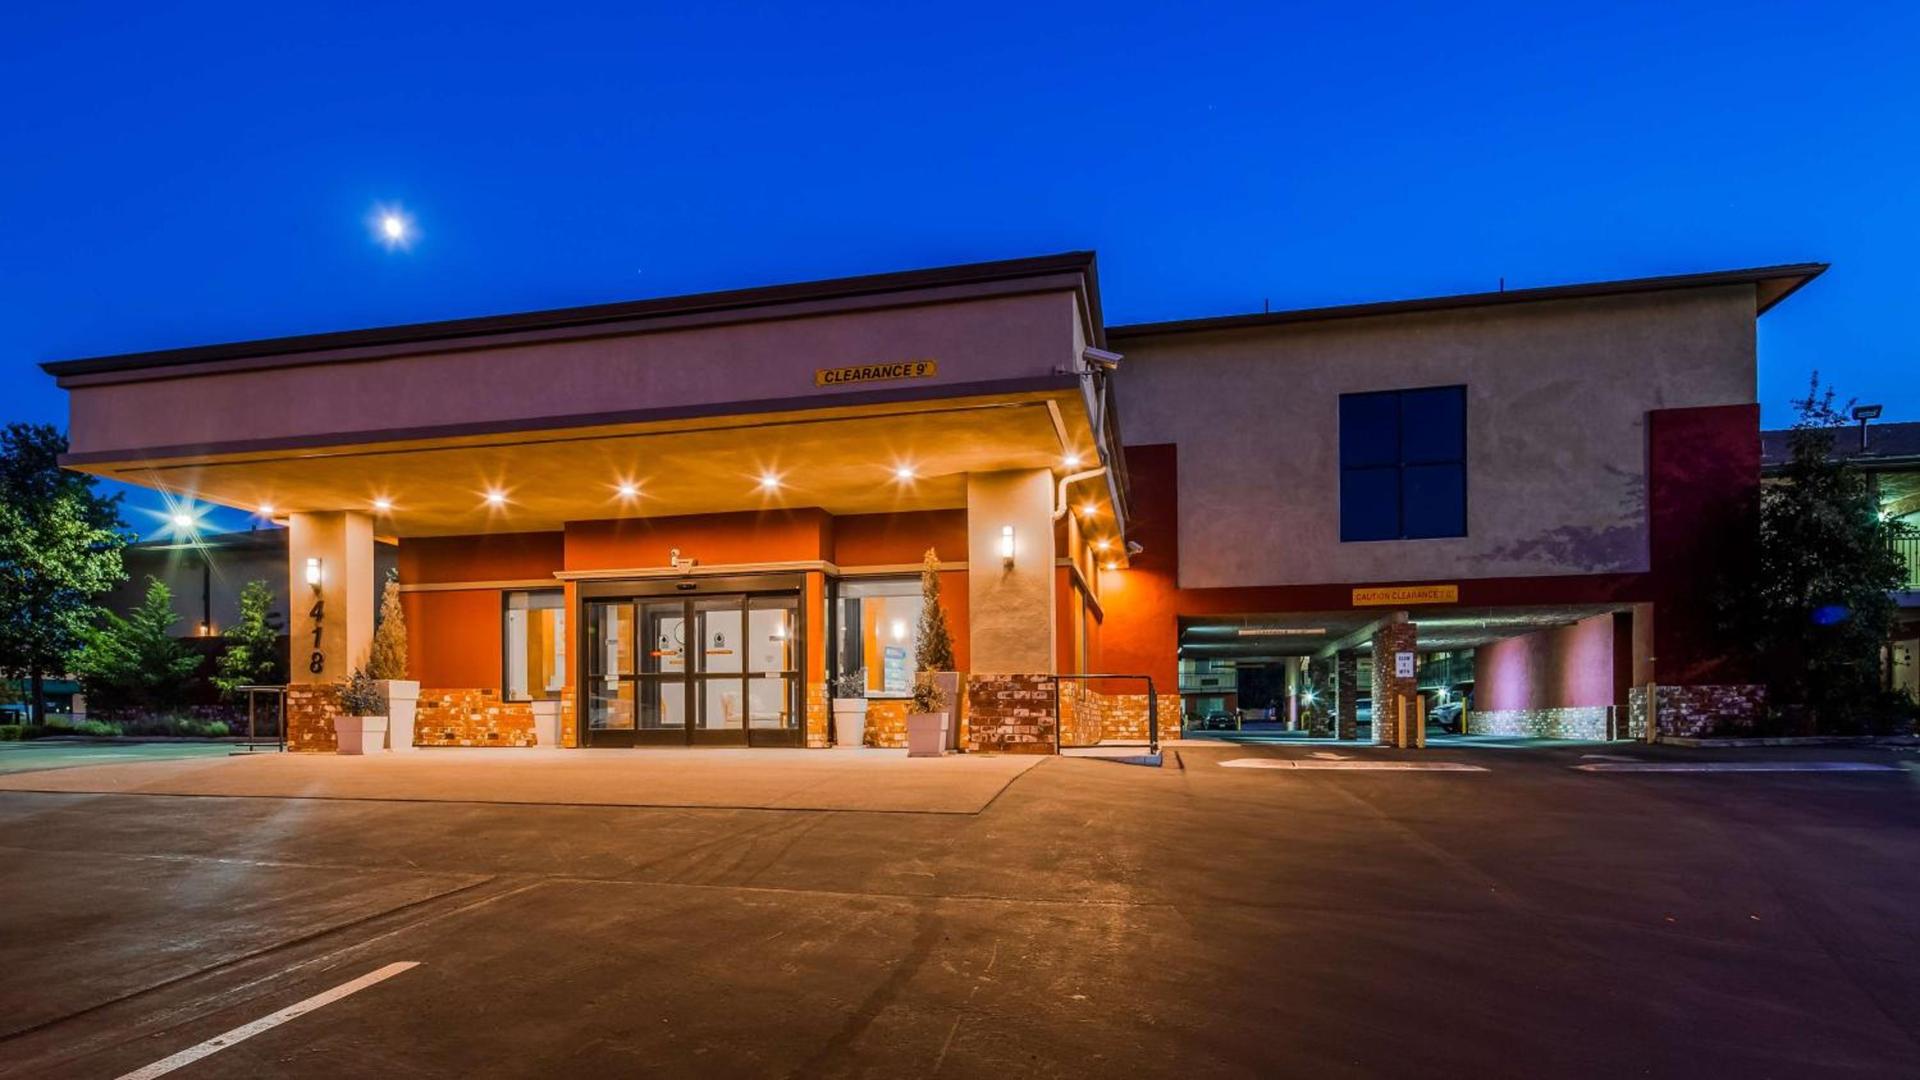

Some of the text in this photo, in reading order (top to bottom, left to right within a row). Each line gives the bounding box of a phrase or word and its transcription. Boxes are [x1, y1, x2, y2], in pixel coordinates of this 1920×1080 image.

[824, 364, 912, 383] CLEARANCE
[1356, 591, 1390, 601] CAUTION
[1391, 589, 1439, 600] CLEARANCE
[309, 600, 325, 674] 418
